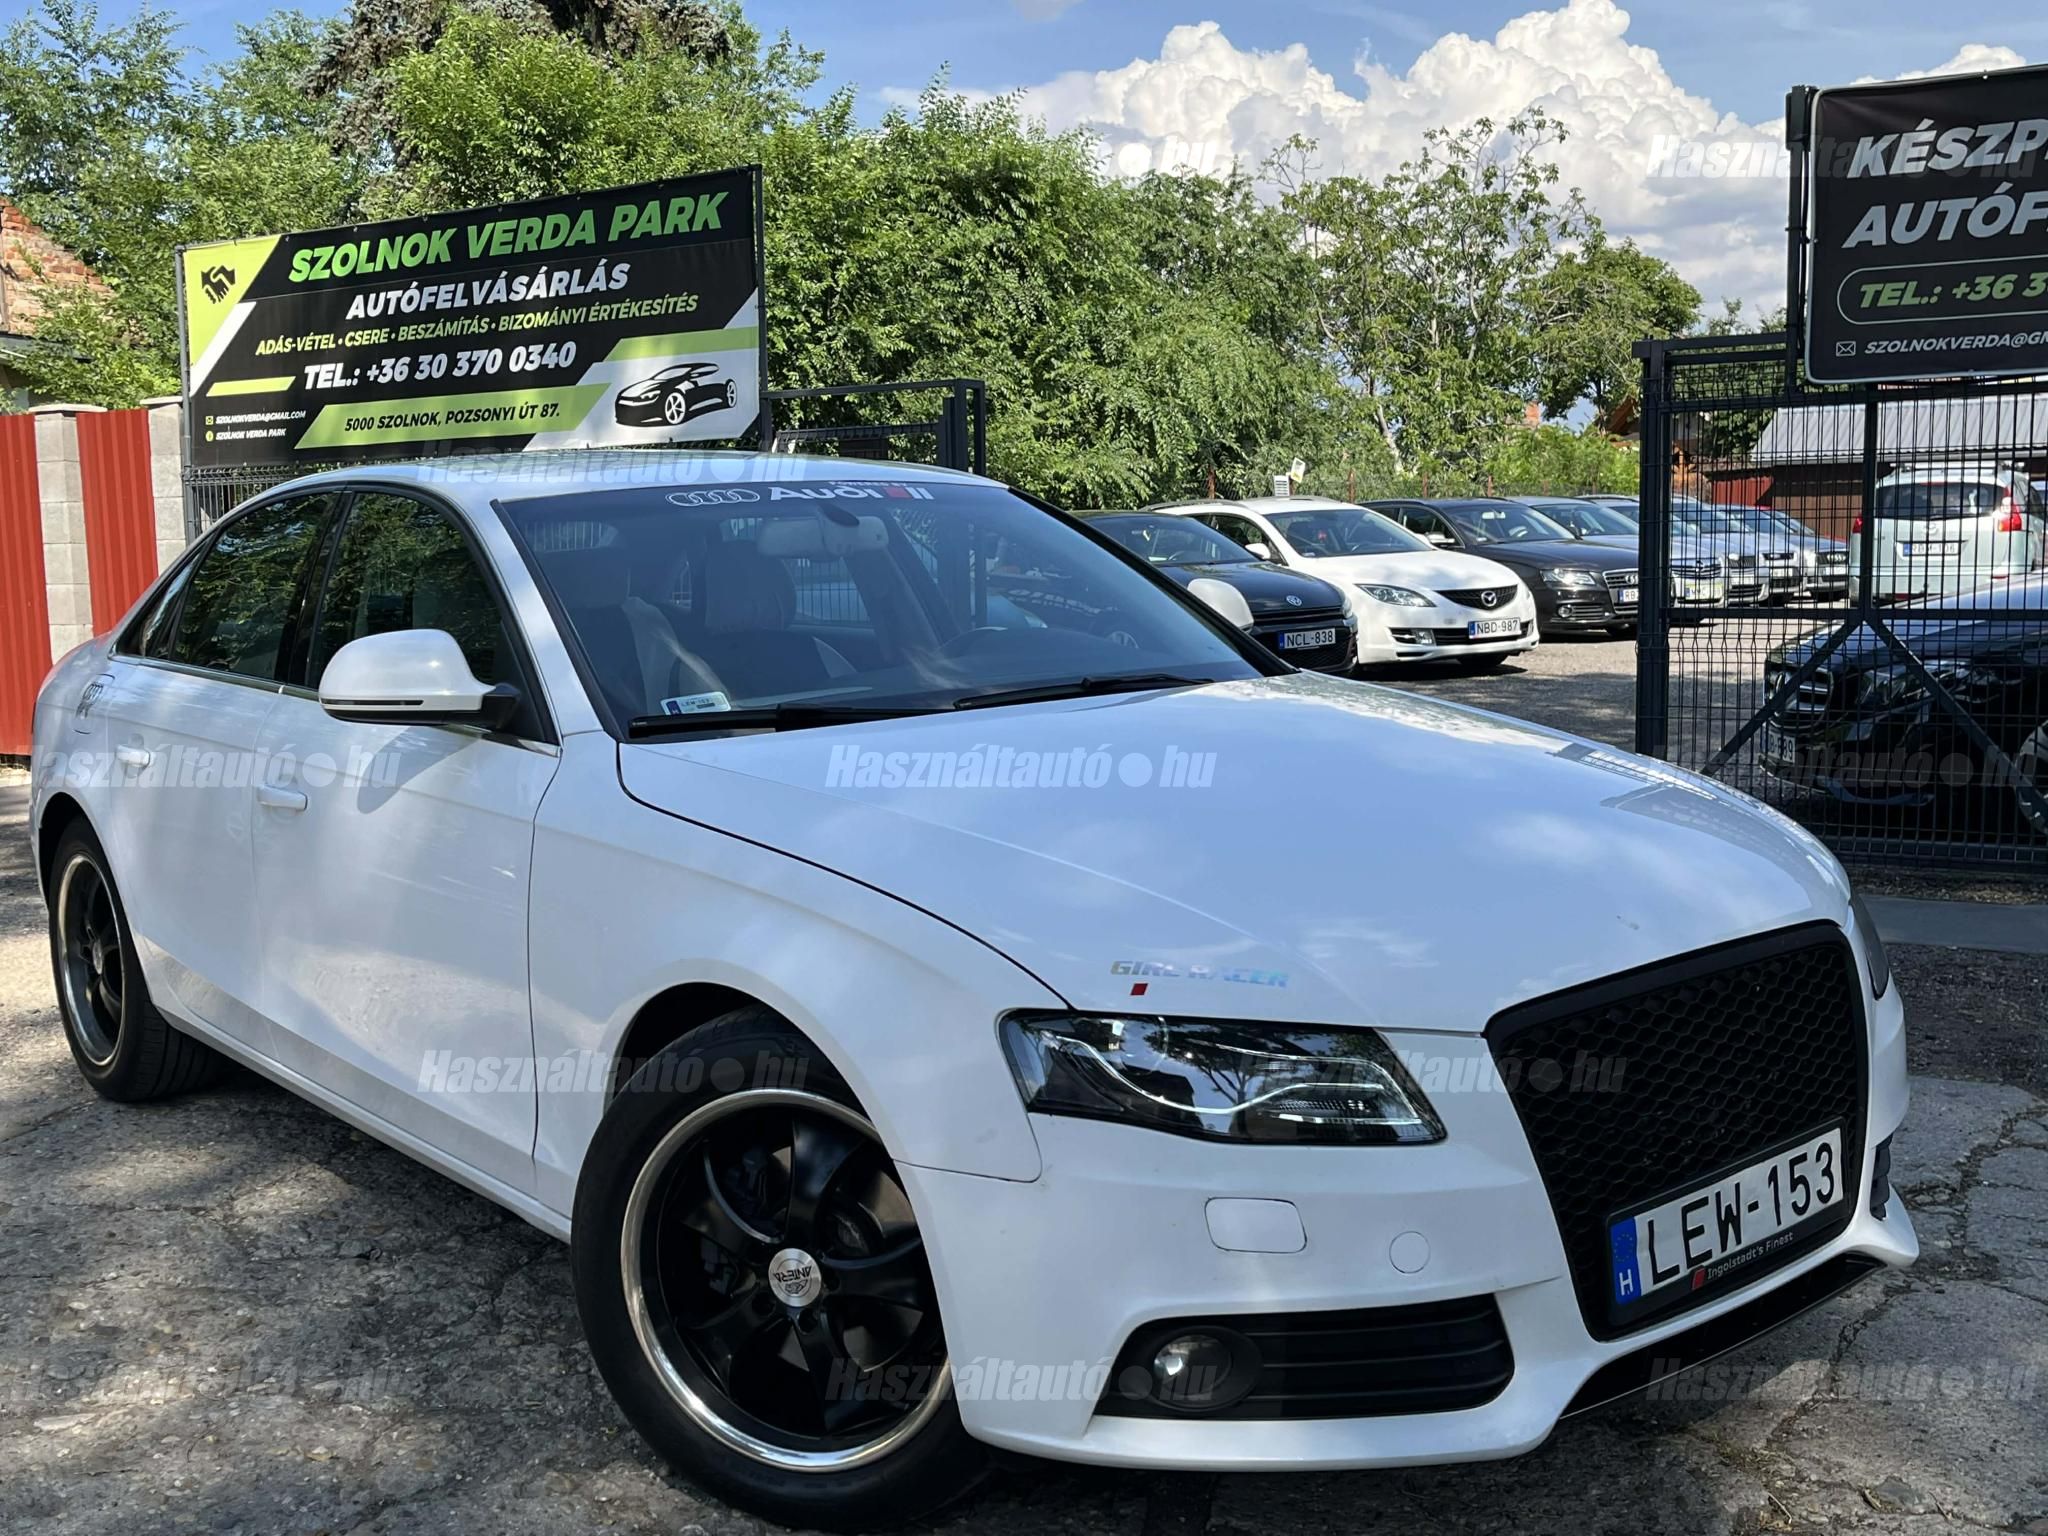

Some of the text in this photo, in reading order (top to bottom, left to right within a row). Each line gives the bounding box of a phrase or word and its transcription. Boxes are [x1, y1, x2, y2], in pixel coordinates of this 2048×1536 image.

[1847, 118, 2048, 179] KÉSZP
[288, 191, 729, 283] SZOLNOK VERDA PARK
[1842, 181, 2048, 249] AUTÓF
[346, 258, 631, 320] AUTÓFELVÁSÁRLÁS
[1860, 271, 2048, 309] TEL.: +36 3
[255, 293, 699, 356] ADÁS-VÉTEL CSERE BESZÁMÍTÁS BIZOMÁNYI ÉRTÉKESÍTÉS
[303, 341, 577, 391] TEL.: +36 30 370 0340
[345, 401, 560, 432] 5000 SZOLNOK, POZSONYI ÚT 87.
[1287, 630, 1334, 647] NCL-838
[1477, 620, 1518, 634] NBD-987
[1647, 1142, 1834, 1285] LEW-153
[1707, 1232, 1794, 1280] Ingolstadt's Finest
